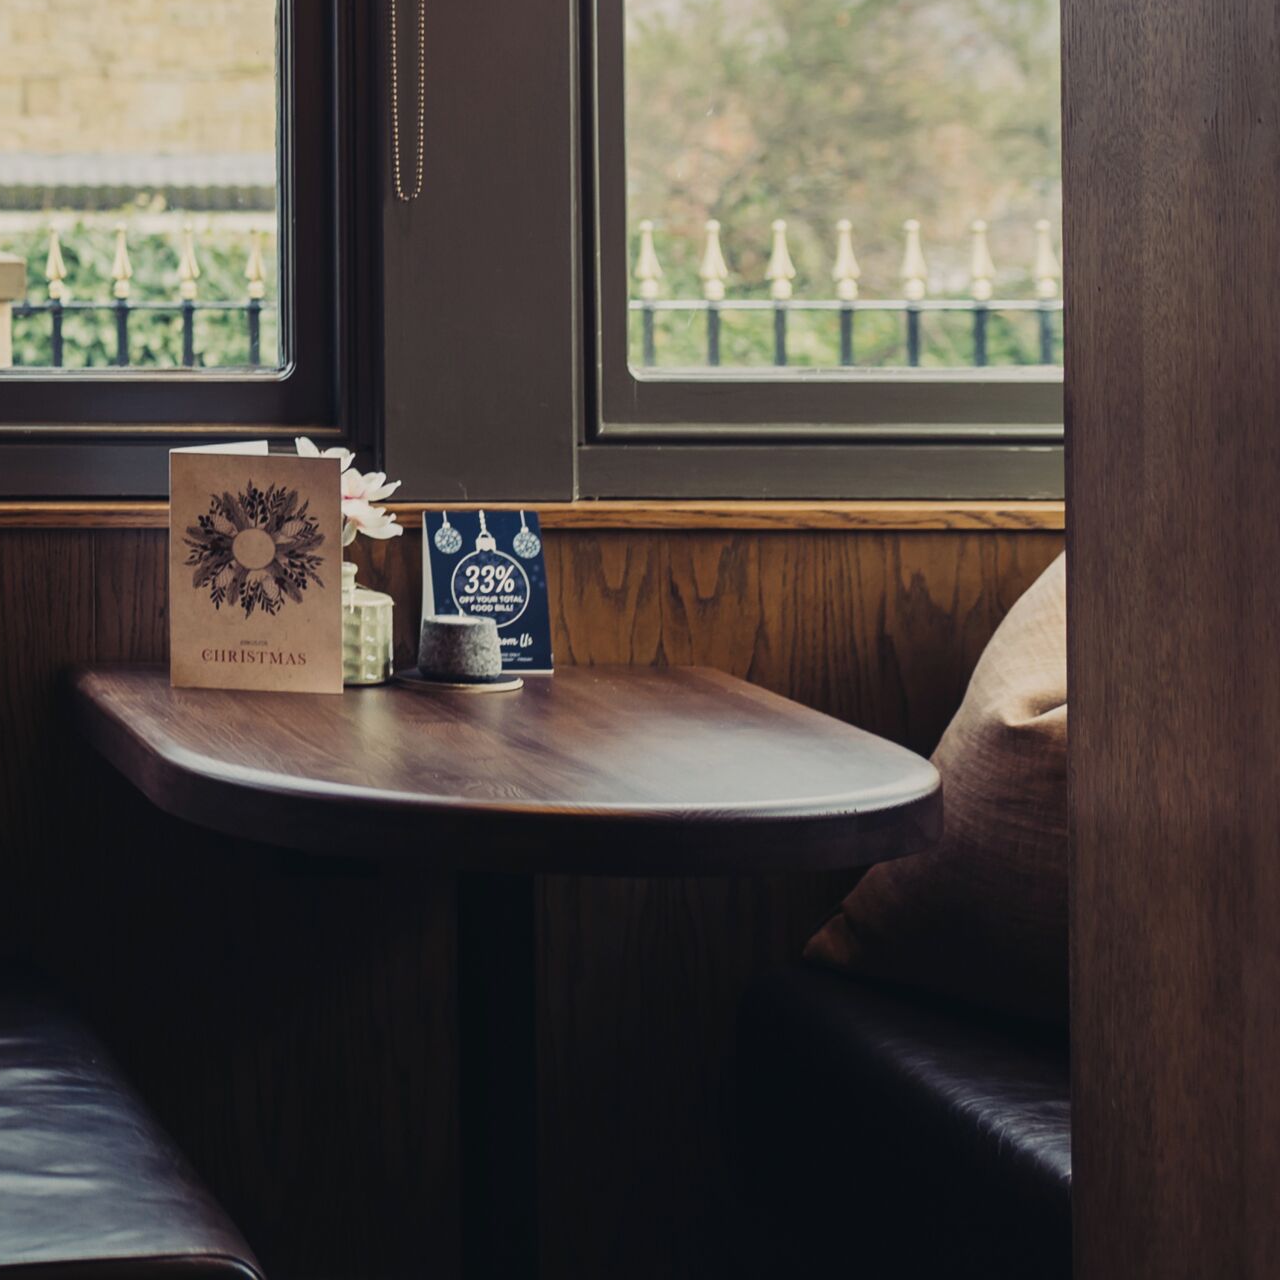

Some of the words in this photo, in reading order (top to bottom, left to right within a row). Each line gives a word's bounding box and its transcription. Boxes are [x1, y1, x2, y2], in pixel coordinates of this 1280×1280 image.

[464, 565, 515, 594] 33%
[459, 595, 475, 604] OFF
[476, 595, 498, 603] YOUR
[500, 594, 524, 603] TOTAL
[471, 604, 493, 612] FOOD
[495, 604, 514, 612] BILL!
[520, 633, 533, 648] Us
[201, 649, 306, 665] CHRISTMAS
